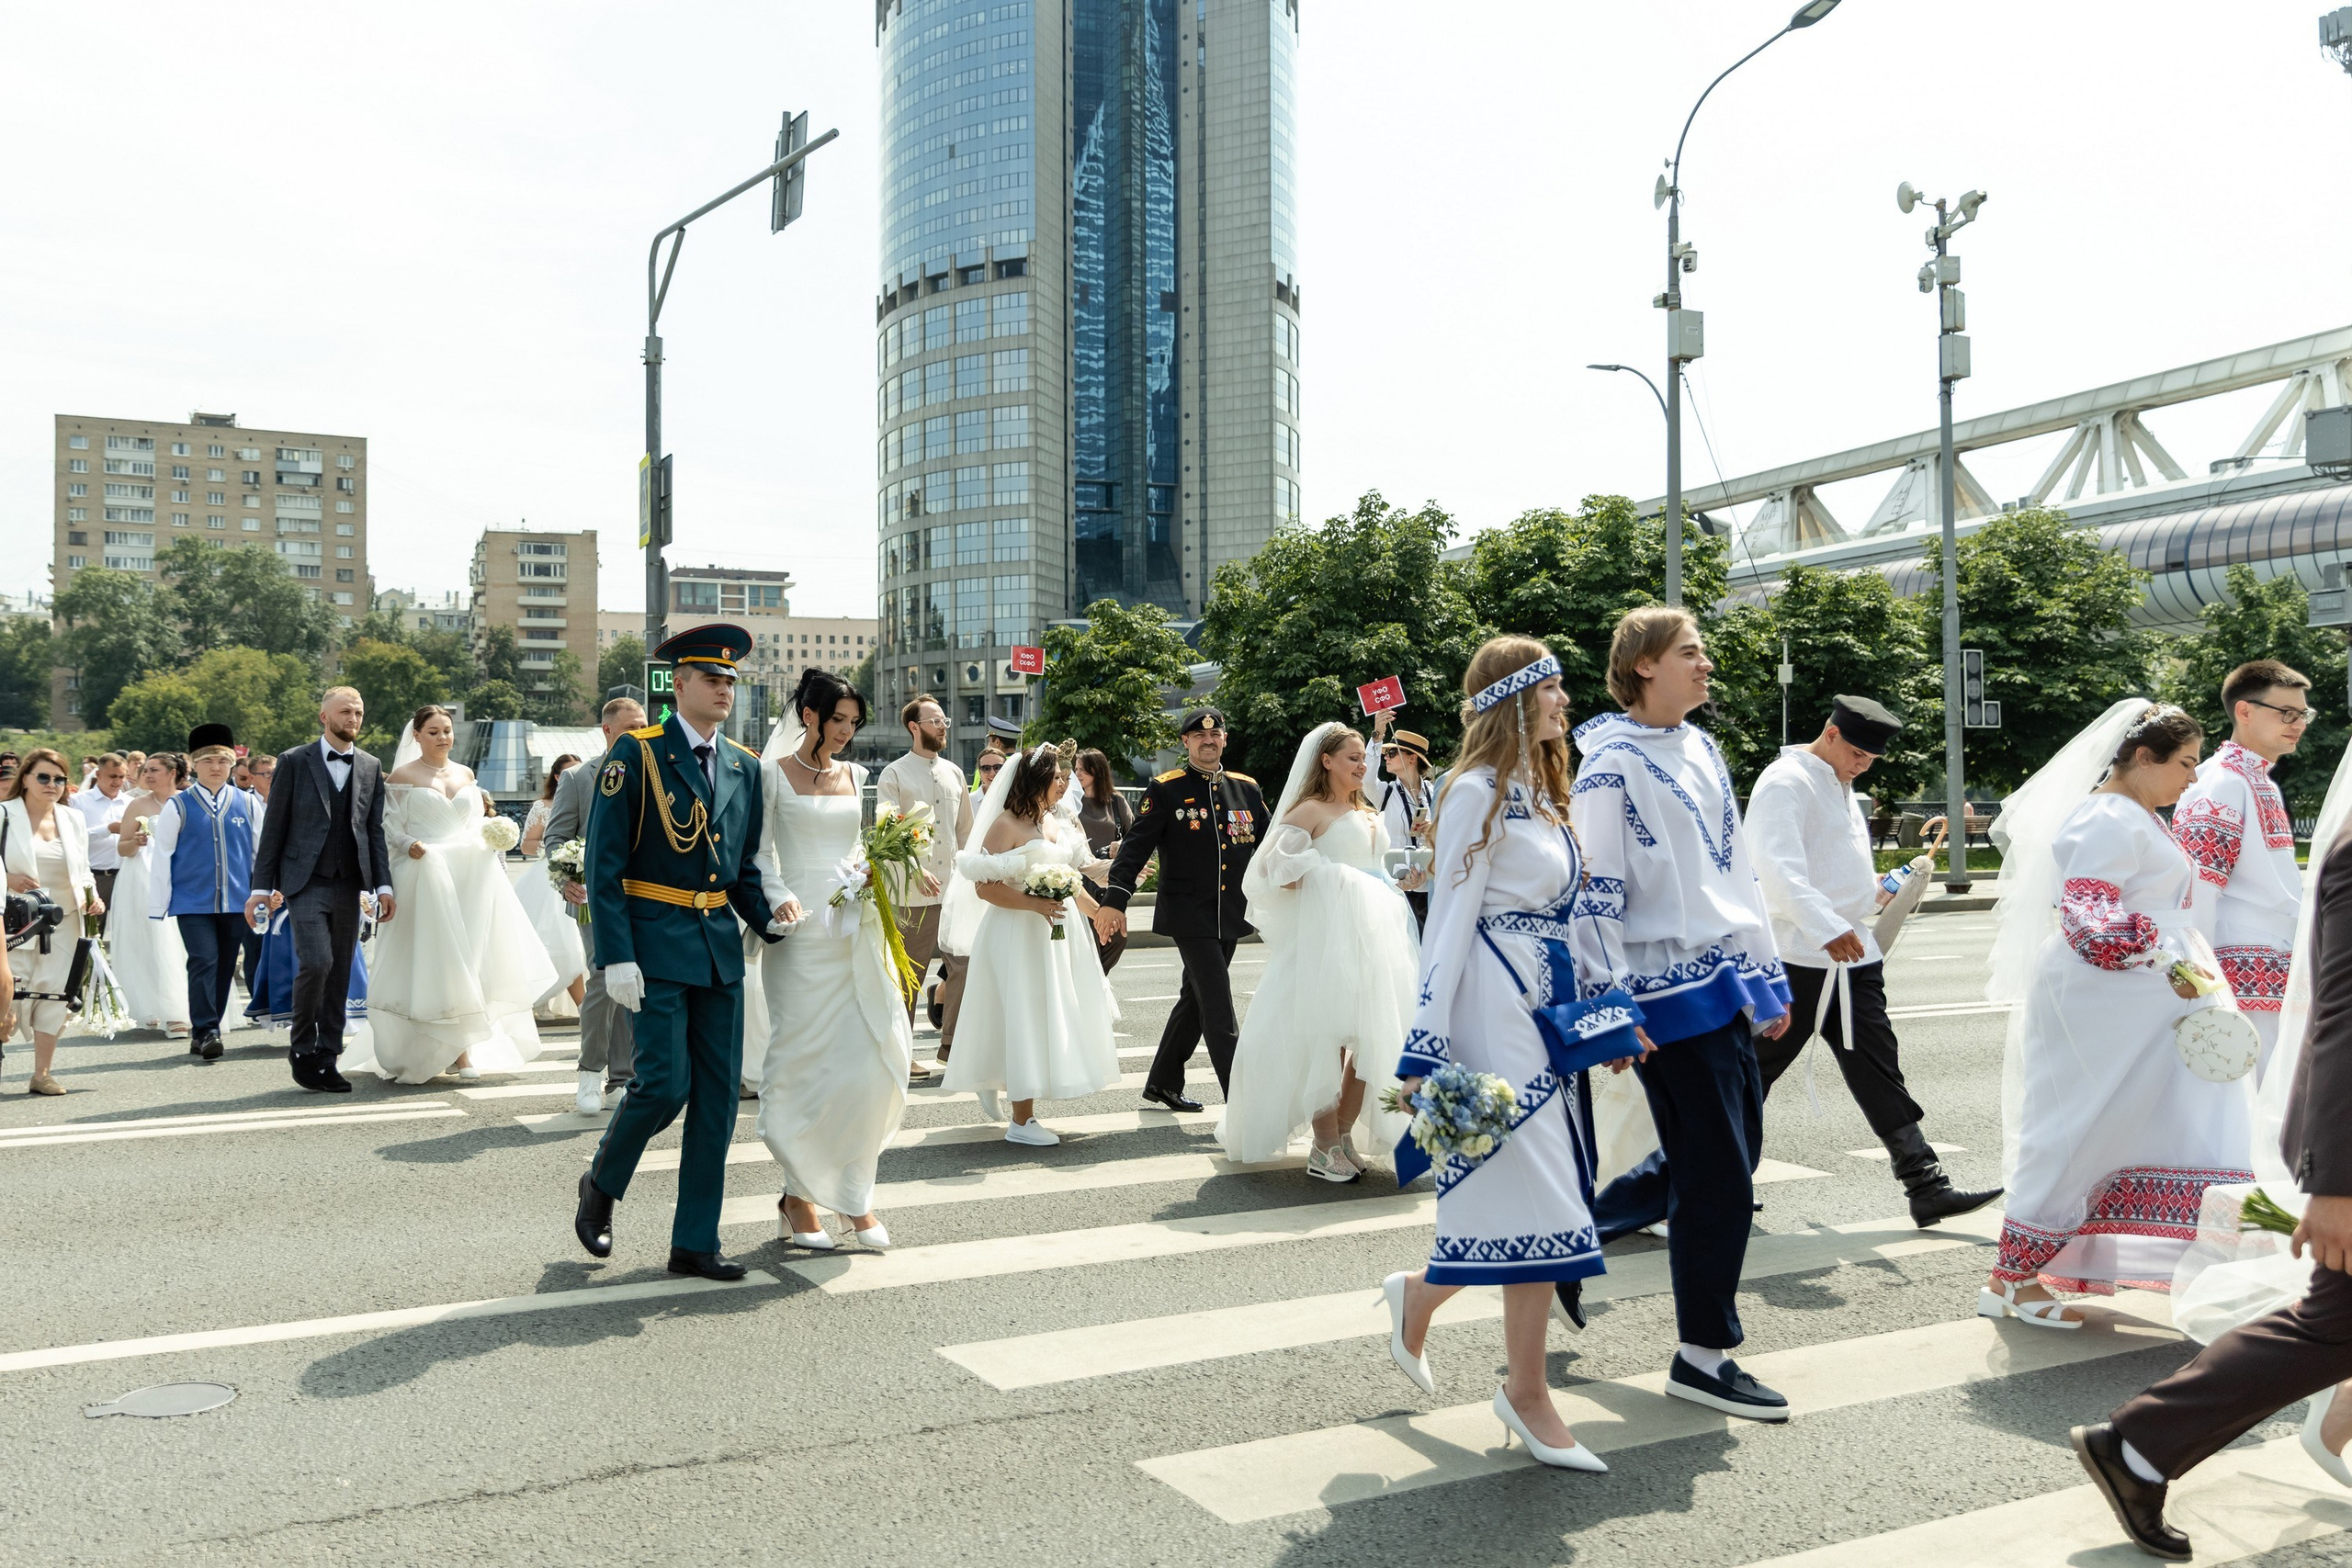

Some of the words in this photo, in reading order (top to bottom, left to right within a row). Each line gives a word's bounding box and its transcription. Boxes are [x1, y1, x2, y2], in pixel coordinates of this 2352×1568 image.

[1372, 686, 1388, 696] УФО
[1374, 694, 1391, 704] СФО
[6, 936, 25, 949] ONIN
